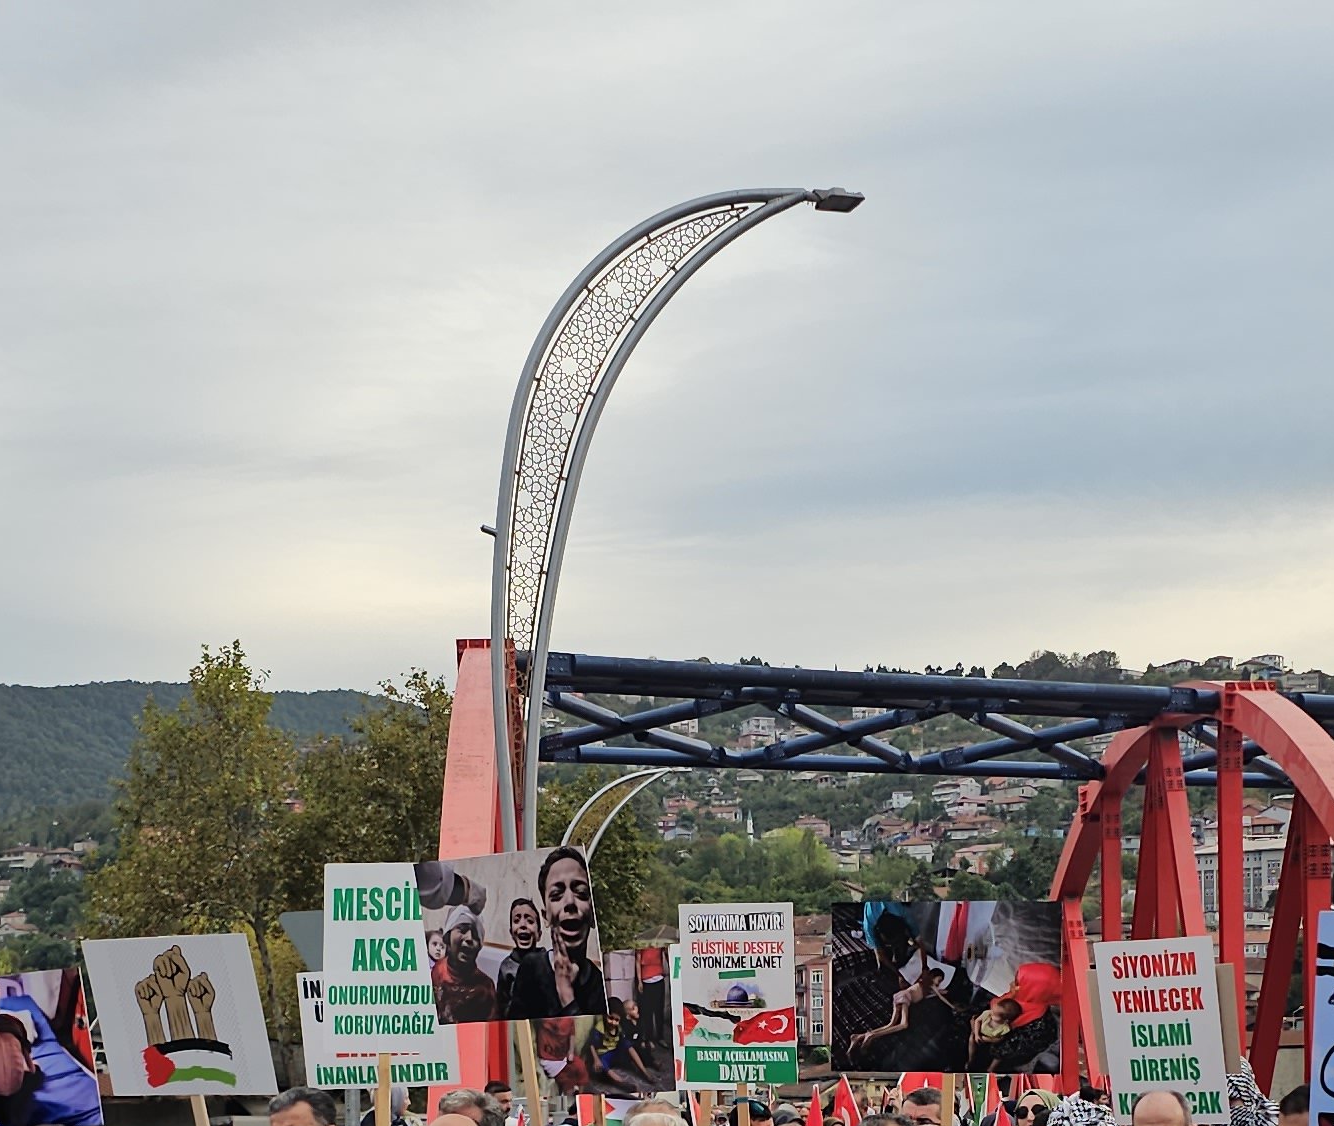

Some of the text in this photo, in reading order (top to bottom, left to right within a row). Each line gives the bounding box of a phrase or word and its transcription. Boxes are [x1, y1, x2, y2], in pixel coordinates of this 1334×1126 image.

[688, 912, 784, 932] SOYKIRIMA HAYIR!
[352, 938, 417, 972] AKSA
[744, 941, 784, 954] DESTEK
[749, 955, 782, 969] LANET
[1111, 950, 1197, 979] SİYONİZM
[328, 985, 435, 1005] ONURUMUZDU
[1112, 986, 1204, 1013] YENİLECEK
[334, 1011, 435, 1035] KORUYACAĞIZ
[1130, 1018, 1192, 1047] İSLAMİ
[696, 1050, 789, 1063] BASIN AÇIKLAMASINA
[316, 1062, 449, 1085] İNANLAINDIR
[719, 1064, 766, 1082] DAVET
[1130, 1053, 1201, 1085] DİRENİŞ
